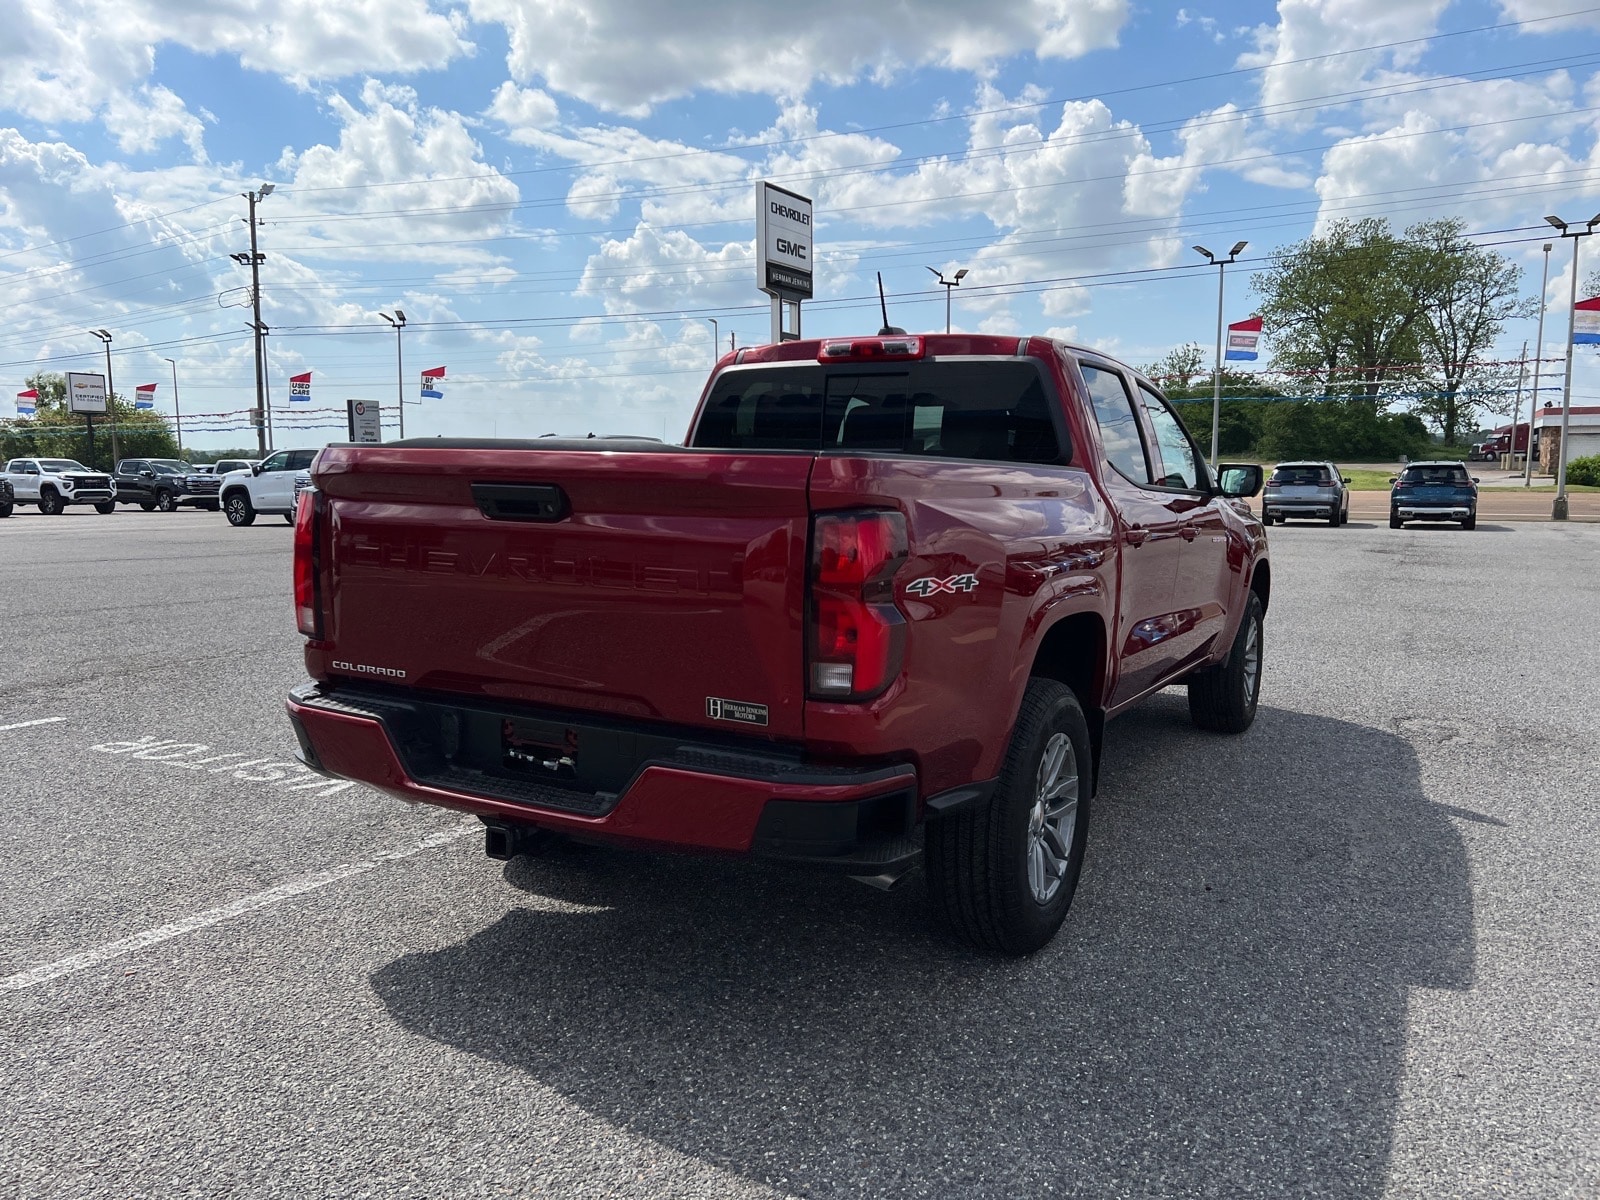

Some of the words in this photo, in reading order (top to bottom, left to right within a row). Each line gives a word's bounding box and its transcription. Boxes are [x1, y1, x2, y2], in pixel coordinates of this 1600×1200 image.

[770, 202, 810, 226] CHEVROLET
[776, 238, 806, 260] GMC
[772, 273, 792, 285] HERMAN
[332, 660, 406, 678] COLORADO
[724, 702, 746, 712] HERMAN
[746, 706, 767, 716] JENKINS
[734, 711, 756, 720] MOTORS
